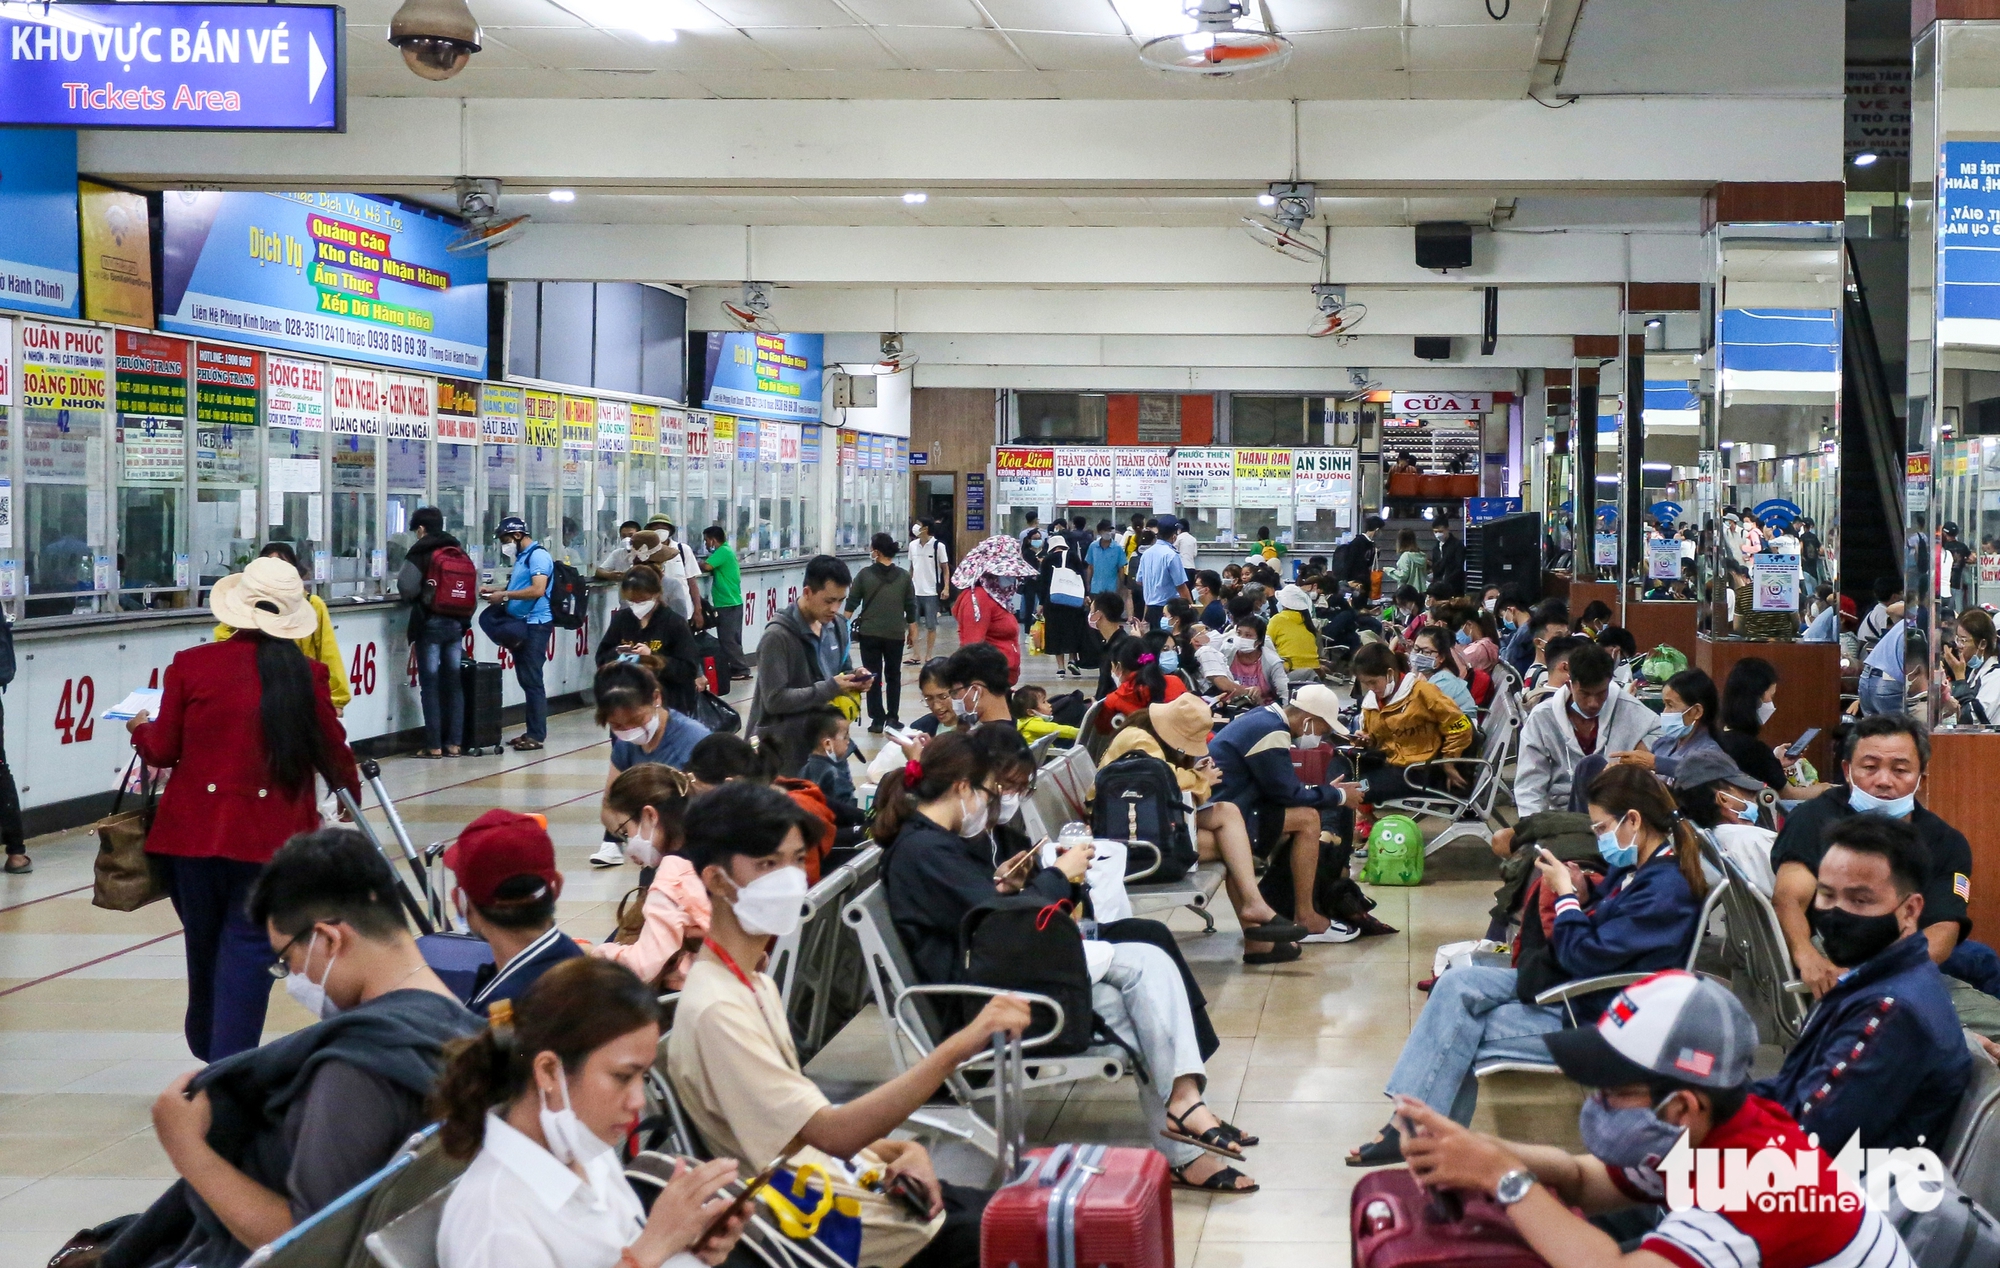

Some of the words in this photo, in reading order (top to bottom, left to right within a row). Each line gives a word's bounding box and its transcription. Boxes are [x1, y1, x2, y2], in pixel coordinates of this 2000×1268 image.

[12, 25, 83, 61] KHU
[92, 22, 161, 72] VỰC
[171, 21, 240, 63] BÁN
[247, 22, 289, 64] VÉ
[62, 82, 166, 110] Tickets
[173, 84, 241, 111] Area
[312, 218, 357, 247] Quảng
[360, 229, 386, 253] Cáo
[248, 225, 283, 267] Dịch
[286, 233, 303, 275] Vụ
[318, 242, 346, 264] Kho
[349, 251, 380, 273] Giao
[382, 258, 415, 284] Nhận
[417, 268, 447, 290] Hàng
[8, 274, 32, 295] Hành
[35, 278, 64, 302] Chính)
[314, 261, 338, 287] Ẩm
[341, 272, 374, 296] Thực
[321, 290, 348, 314] Xếp
[352, 299, 369, 318] Dỡ
[373, 303, 404, 327] Hàng
[407, 309, 431, 331] Hóa
[192, 303, 208, 321] Liên
[220, 308, 242, 329] Phòng
[243, 311, 259, 330] Kinh
[260, 314, 282, 334] Doanh:
[285, 317, 345, 346] 028-35112410
[346, 328, 366, 350] hoặc
[367, 328, 389, 351] 0938
[391, 333, 402, 353] 69
[404, 336, 415, 355] 69
[416, 338, 428, 358] 38
[65, 329, 104, 355] PHÚC
[116, 354, 151, 373] PHƯƠNG
[153, 361, 182, 375] TRANG
[70, 372, 105, 398] DŨNG
[197, 367, 228, 383] PHƯƠNG
[229, 372, 255, 387] TRANG
[303, 363, 323, 391] HẢI
[24, 395, 54, 407] QUY
[61, 398, 105, 410] NHƠN
[268, 399, 291, 411] LEIKU
[297, 402, 306, 413] AN
[1404, 395, 1462, 411] CỬA
[1470, 399, 1481, 410] I
[687, 427, 709, 456] HUẾ
[998, 451, 1023, 468] Hòa
[1024, 451, 1053, 469] Liêm
[1057, 452, 1086, 467] THÀNH
[1088, 453, 1111, 467] CÔNG
[1116, 452, 1145, 467] THÀNH
[1148, 453, 1171, 467] CÔNG
[1177, 450, 1204, 458] PHƯỚC
[1206, 450, 1230, 459] THIỆN
[1296, 457, 1315, 471] AN
[1319, 456, 1351, 471] SINH
[1057, 466, 1073, 477] BÙ
[1077, 467, 1111, 477] ĐĂNG
[1208, 469, 1230, 477] SƠN
[1237, 468, 1247, 478] TUY
[1248, 466, 1258, 478] HÒA
[1263, 466, 1277, 478] SÔNG
[1296, 471, 1313, 480] HẢI
[1316, 471, 1351, 480] DƯƠNG
[1200, 478, 1208, 487] 70
[1259, 478, 1267, 487] 71
[349, 641, 377, 697] 46
[54, 676, 95, 746] 42
